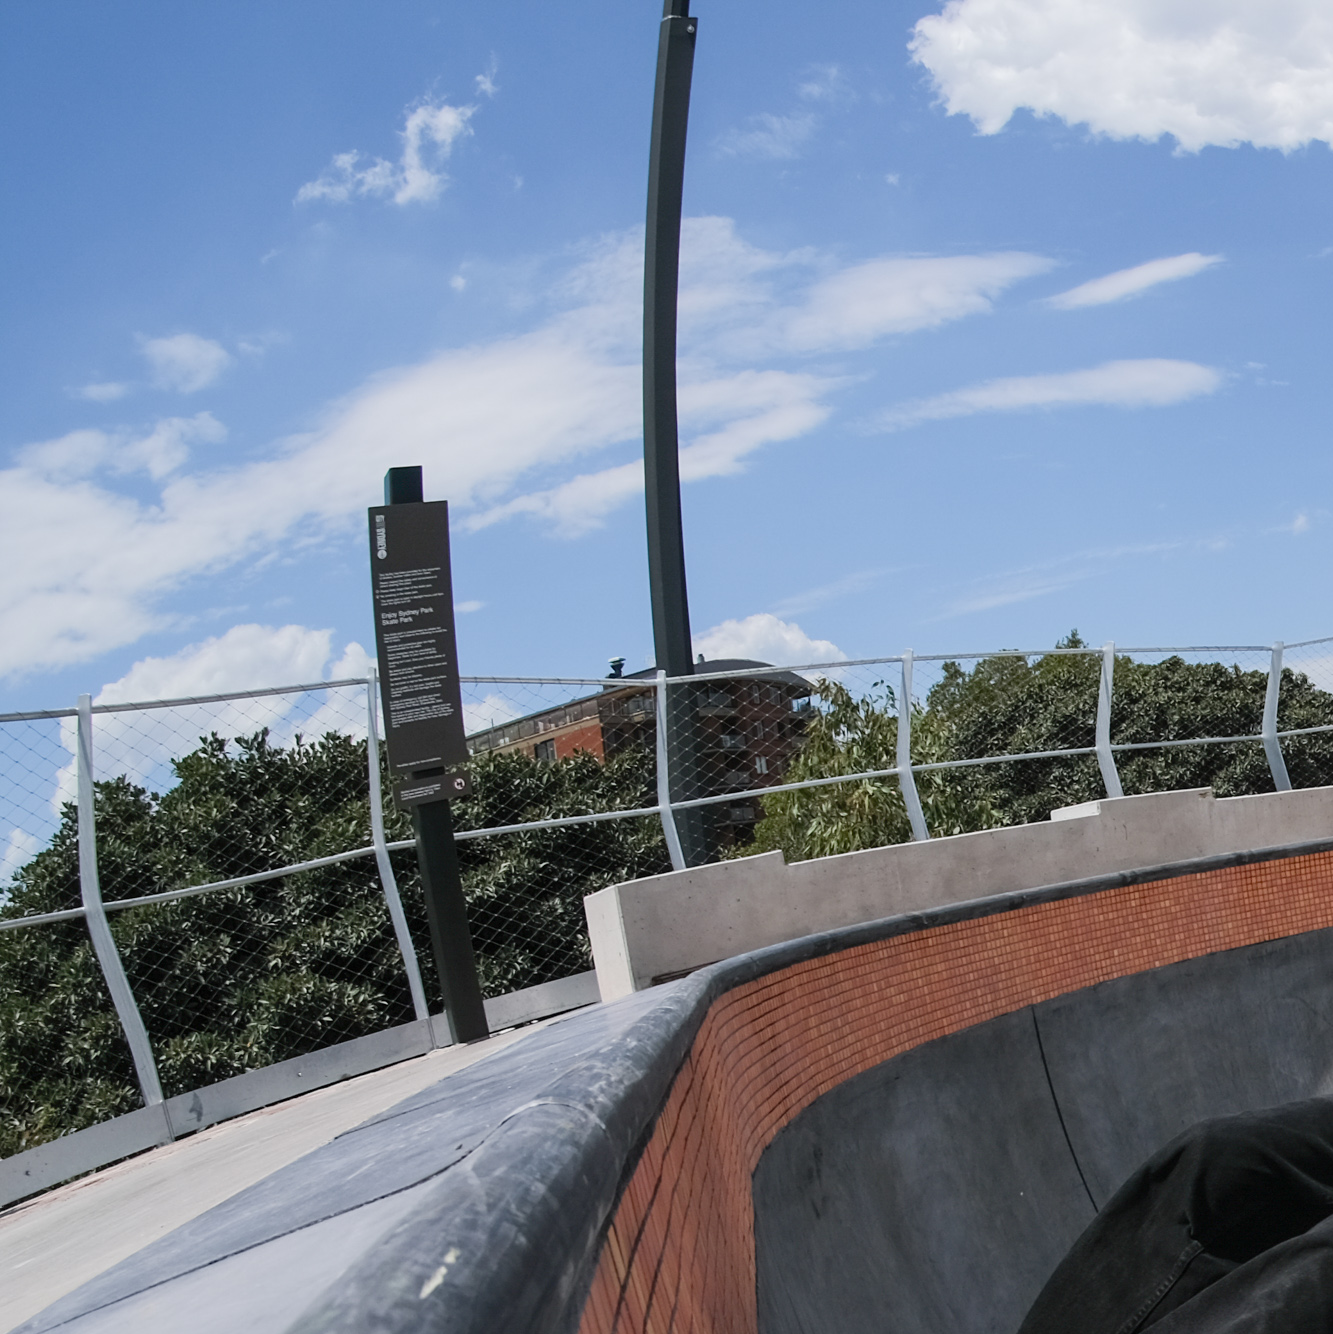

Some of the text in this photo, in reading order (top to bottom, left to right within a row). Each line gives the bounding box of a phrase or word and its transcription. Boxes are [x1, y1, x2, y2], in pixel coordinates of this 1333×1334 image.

[381, 611, 397, 619] Enjoy
[398, 609, 419, 617] Sydney
[382, 618, 399, 626] Skate
